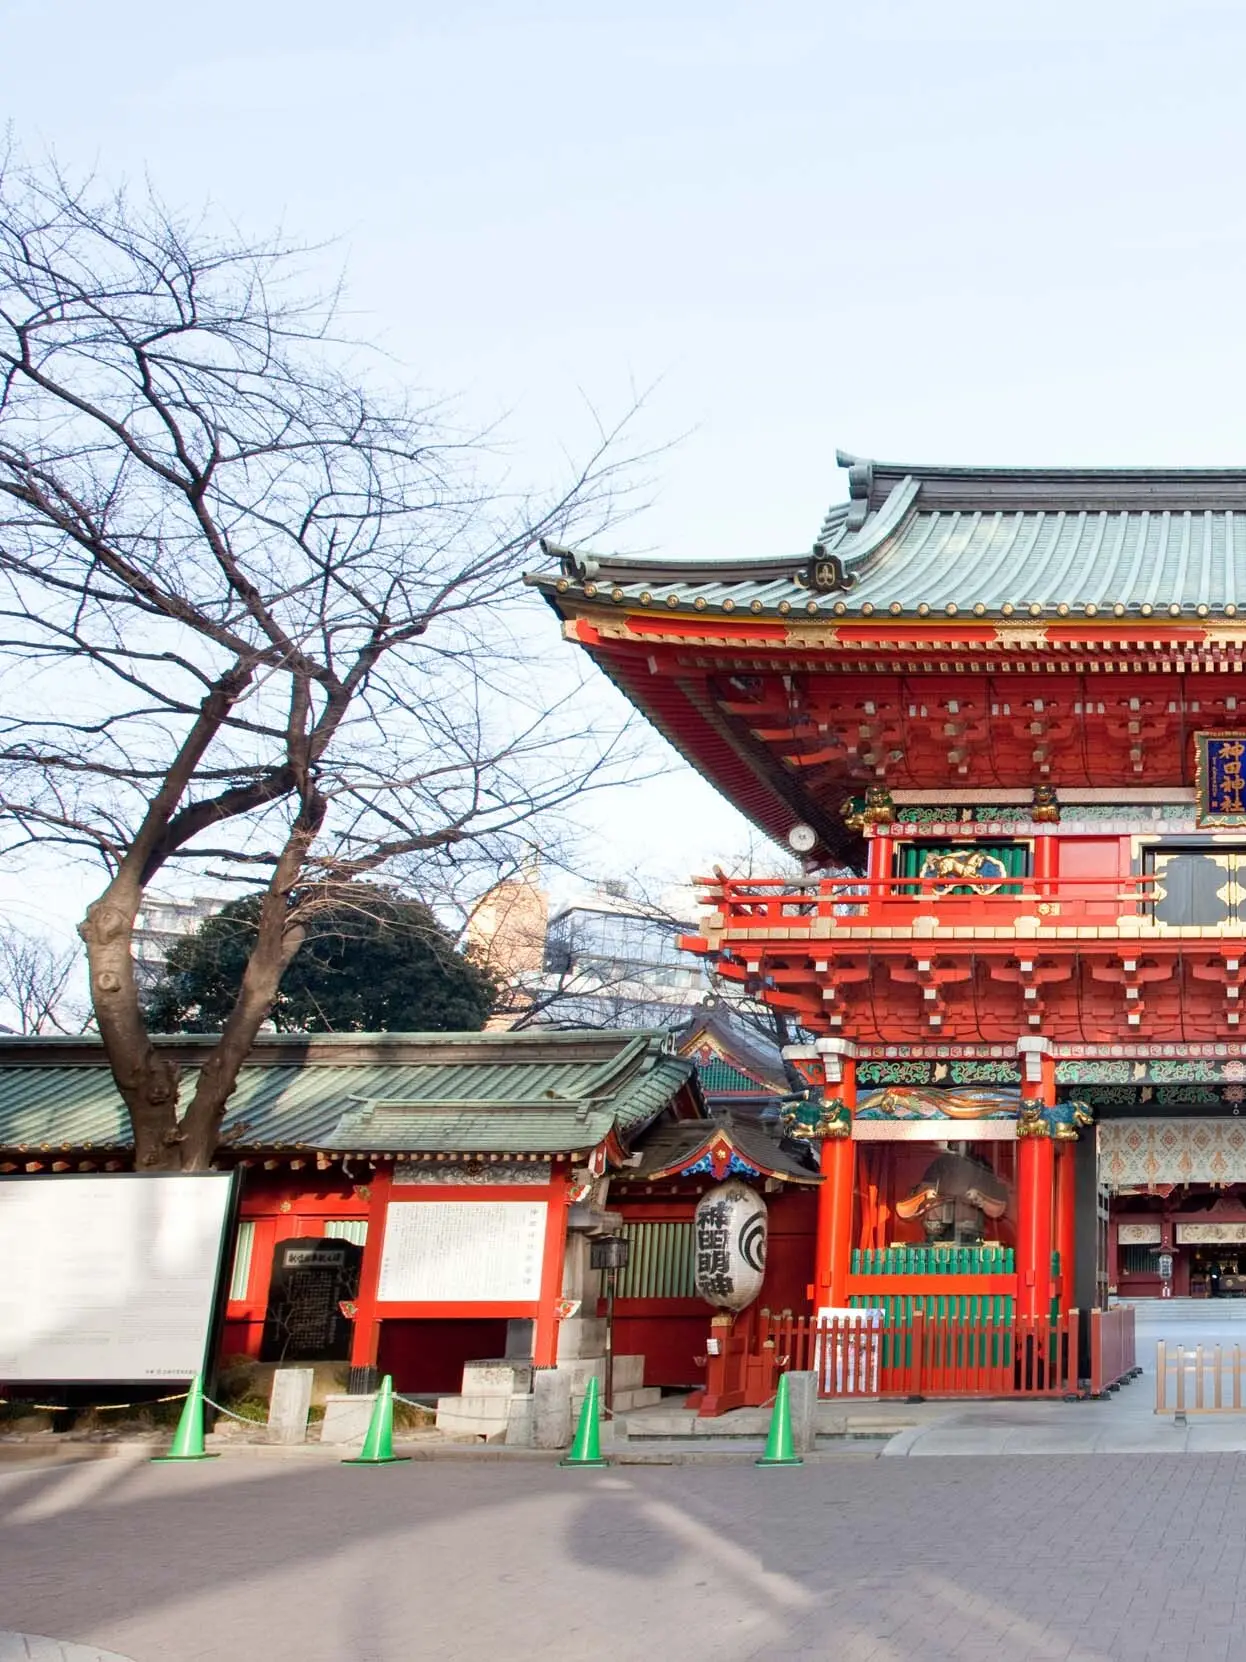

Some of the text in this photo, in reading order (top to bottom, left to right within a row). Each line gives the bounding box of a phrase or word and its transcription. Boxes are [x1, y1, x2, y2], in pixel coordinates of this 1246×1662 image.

[1218, 741, 1246, 812] 神田神社
[697, 1201, 734, 1296] 神田明神
